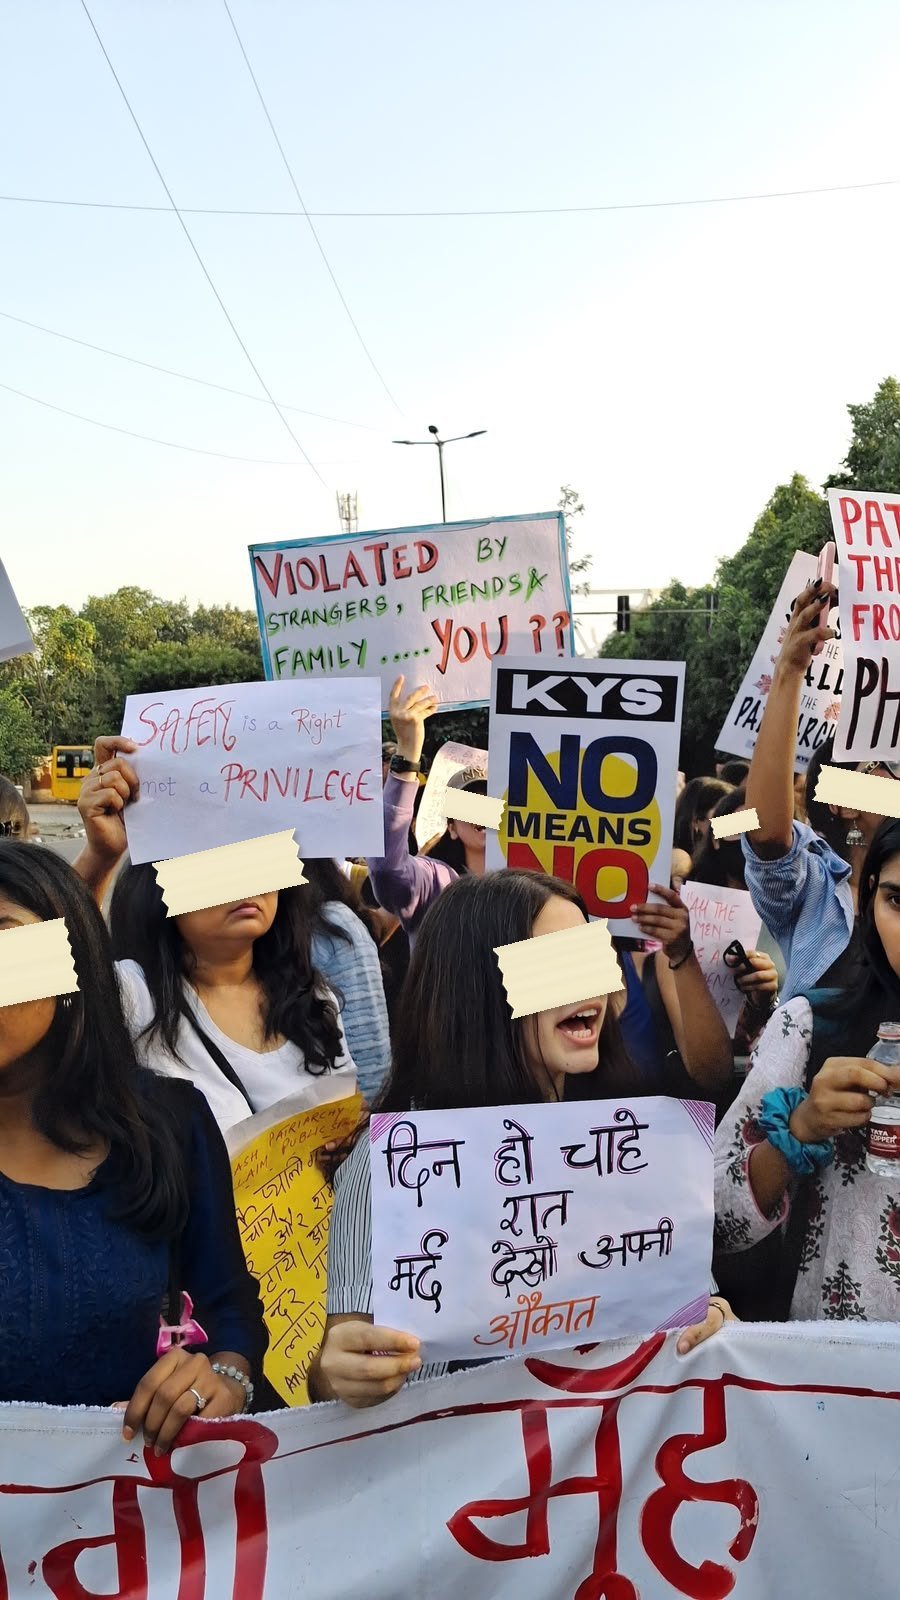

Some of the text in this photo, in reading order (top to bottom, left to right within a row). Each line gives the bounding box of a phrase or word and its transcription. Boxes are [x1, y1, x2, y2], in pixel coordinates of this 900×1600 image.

[255, 536, 508, 598] VIOLATED BY
[848, 554, 900, 593] TH
[274, 638, 368, 678] FAMILY
[511, 673, 663, 716] KYS
[137, 698, 347, 754] SAFETY is a Right
[143, 763, 375, 804] not a PRIVILEGE
[508, 731, 658, 814] NO
[507, 810, 652, 847] MEANS
[870, 1128, 889, 1137] TATA
[382, 1108, 650, 1207] दिन हो चाहे
[500, 1189, 574, 1237] रात
[388, 1228, 449, 1313] मर्द
[491, 1234, 559, 1298] देखो
[577, 1216, 674, 1270] अपनी
